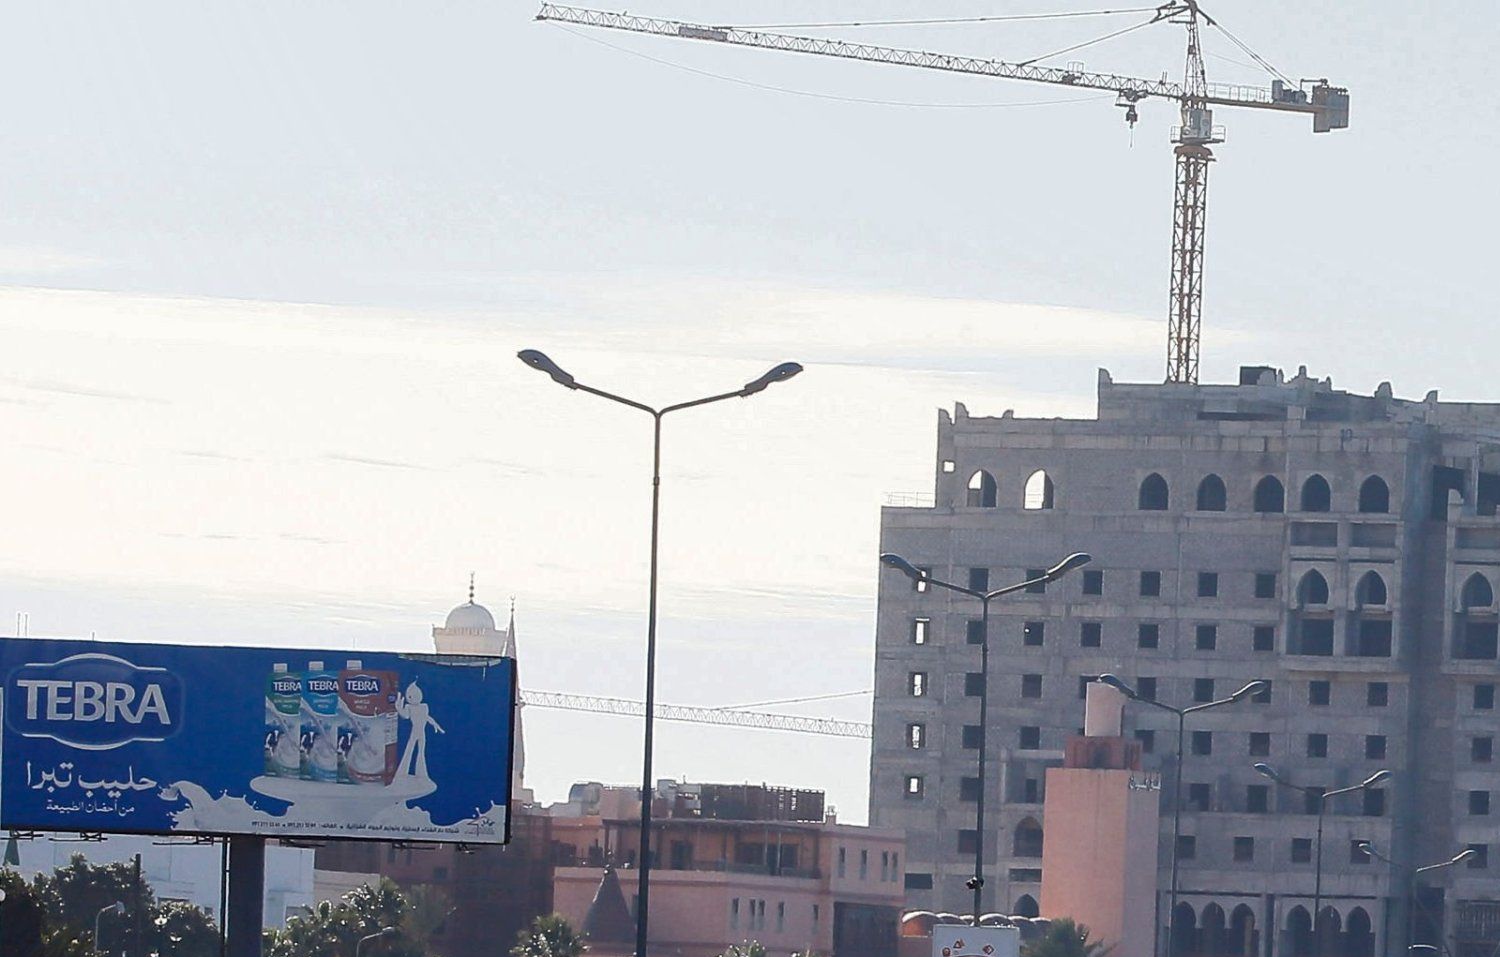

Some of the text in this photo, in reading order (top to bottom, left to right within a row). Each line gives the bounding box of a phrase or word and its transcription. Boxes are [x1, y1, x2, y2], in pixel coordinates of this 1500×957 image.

[273, 681, 302, 692] TEBRA
[308, 680, 339, 692] TEBRA
[346, 680, 379, 692] TEBRA
[16, 679, 172, 725] TEBRA
[26, 760, 158, 798] حليب تبرا
[118, 805, 135, 817] من
